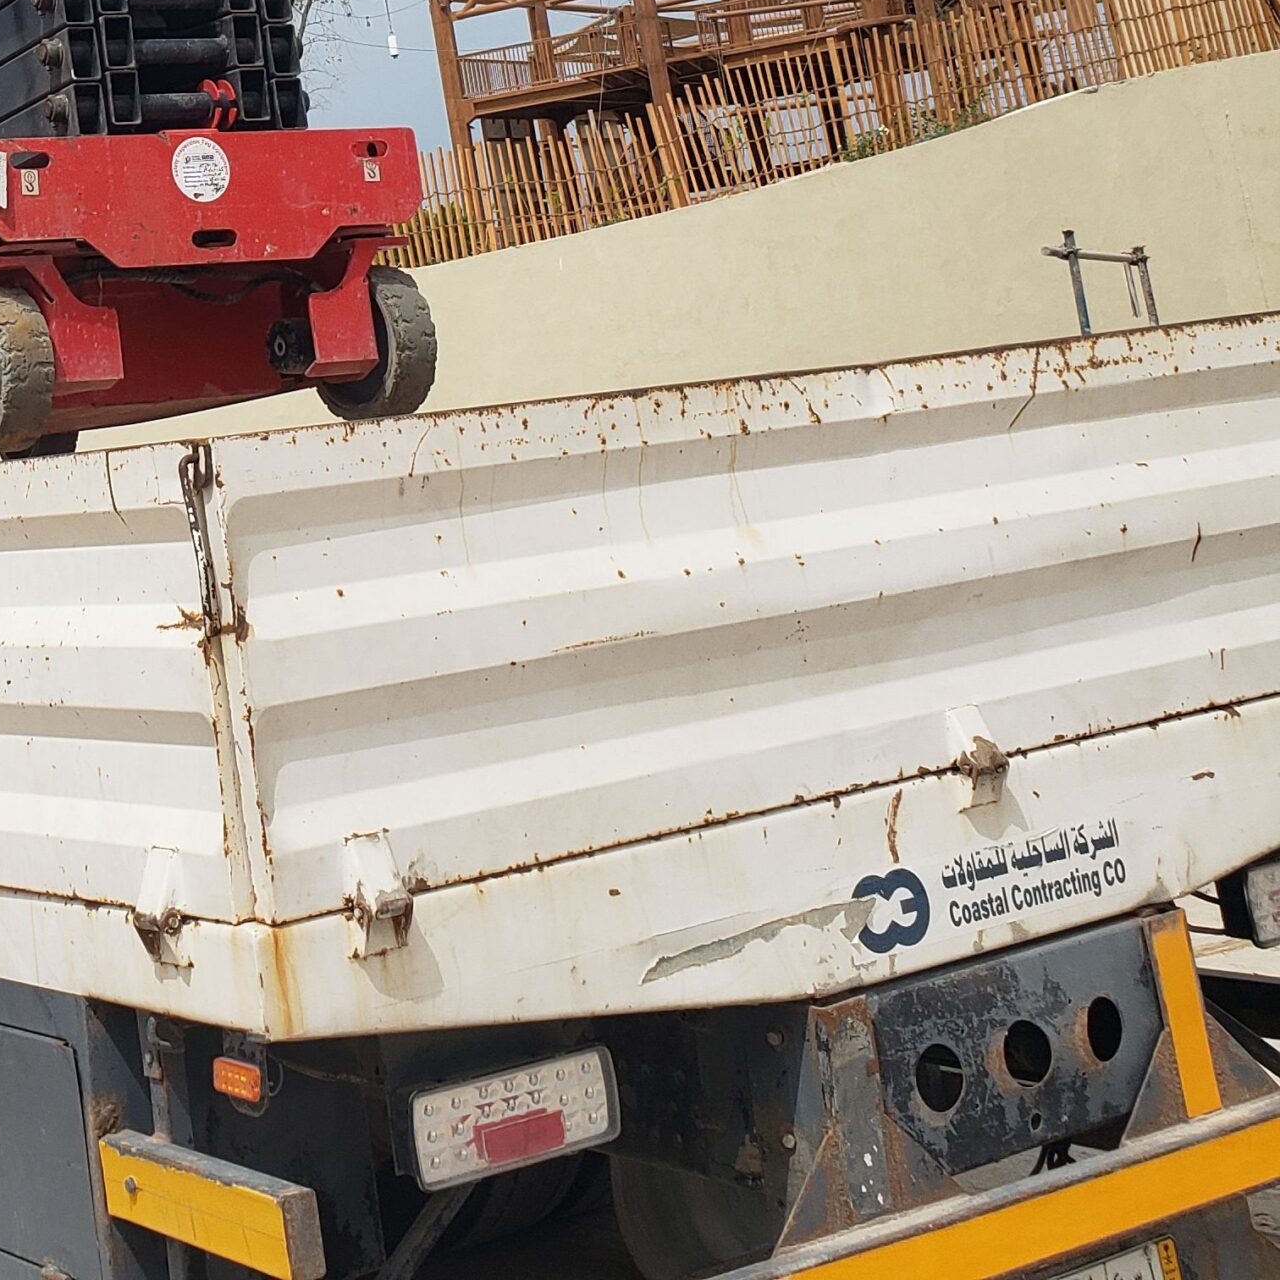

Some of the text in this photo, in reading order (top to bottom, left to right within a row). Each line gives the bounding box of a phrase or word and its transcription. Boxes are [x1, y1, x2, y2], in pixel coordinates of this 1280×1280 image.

[941, 817, 1119, 891] الشركة الساحلية للمقاولات
[949, 858, 1126, 927] Coastal Contracting CO
